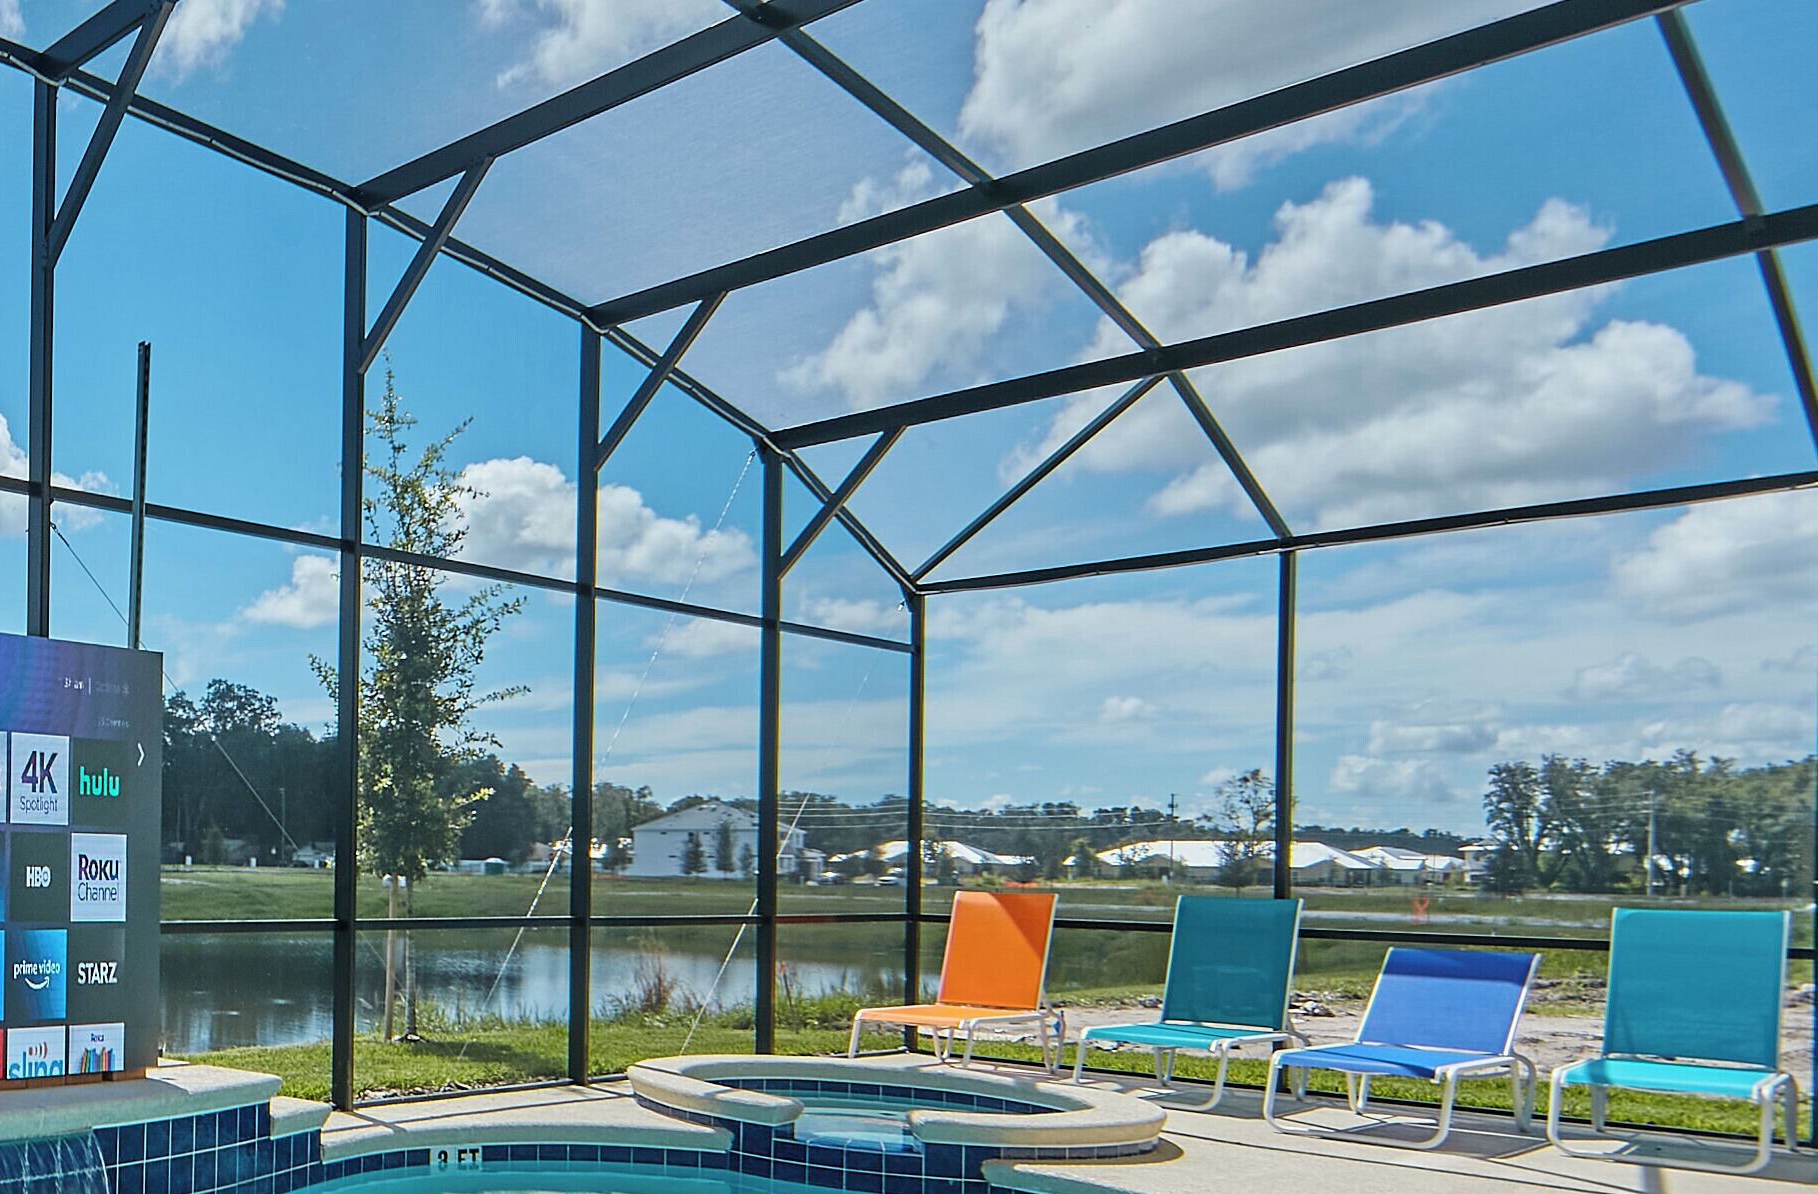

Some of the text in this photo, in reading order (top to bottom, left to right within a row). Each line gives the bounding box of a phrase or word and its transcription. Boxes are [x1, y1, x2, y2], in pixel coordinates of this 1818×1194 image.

[21, 750, 58, 794] 4K
[79, 766, 120, 797] hulu
[20, 796, 58, 814] Spotlight
[26, 866, 51, 888] HBO
[78, 854, 119, 881] Roku
[78, 883, 120, 901] Channel
[13, 960, 61, 979] prime video
[78, 962, 118, 985] STARZ
